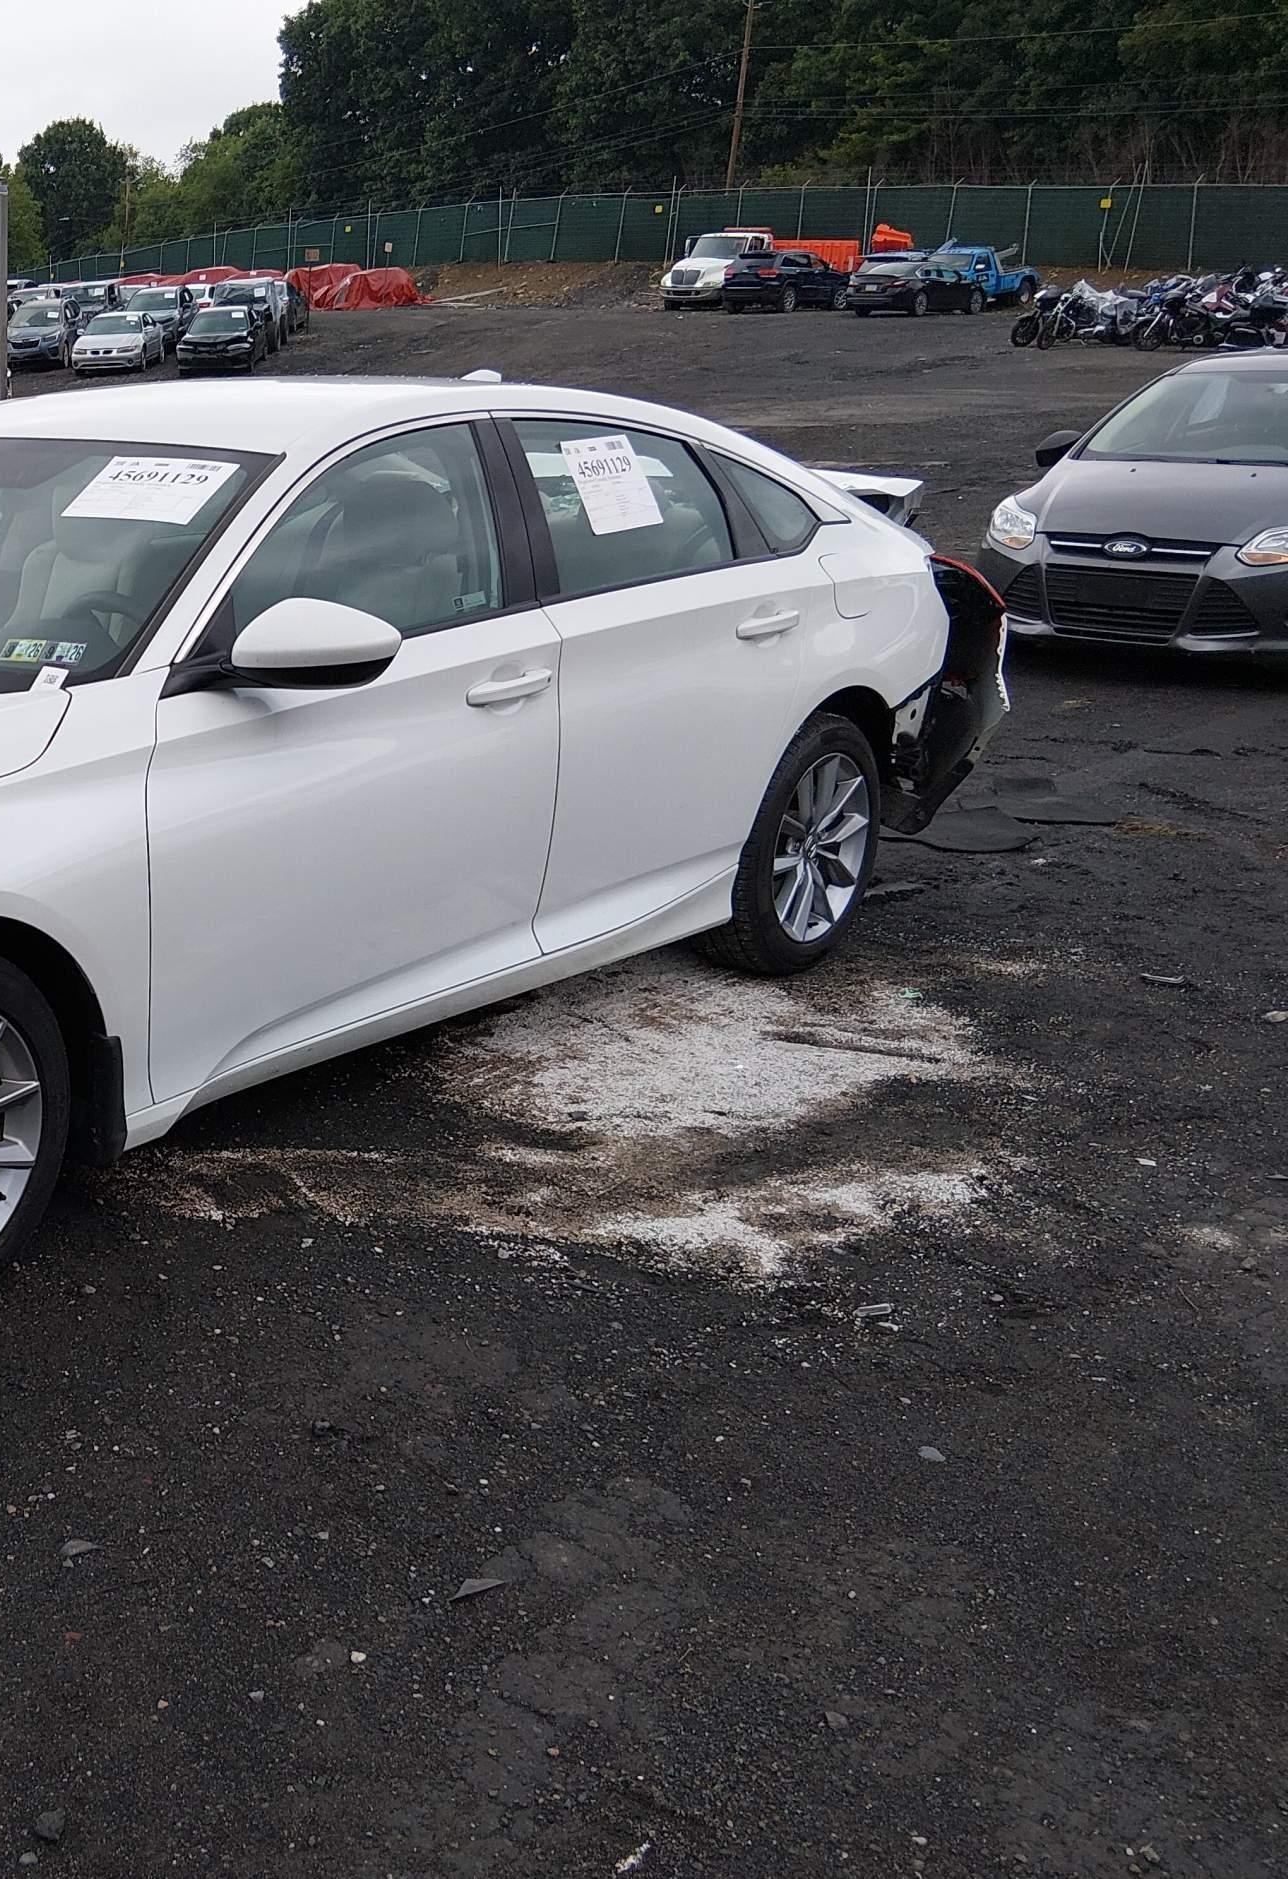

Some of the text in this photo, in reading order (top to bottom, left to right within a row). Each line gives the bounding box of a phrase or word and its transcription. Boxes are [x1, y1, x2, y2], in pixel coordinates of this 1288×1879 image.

[577, 455, 632, 478] 45691129
[108, 470, 209, 485] 45691129
[1112, 543, 1137, 553] Ford
